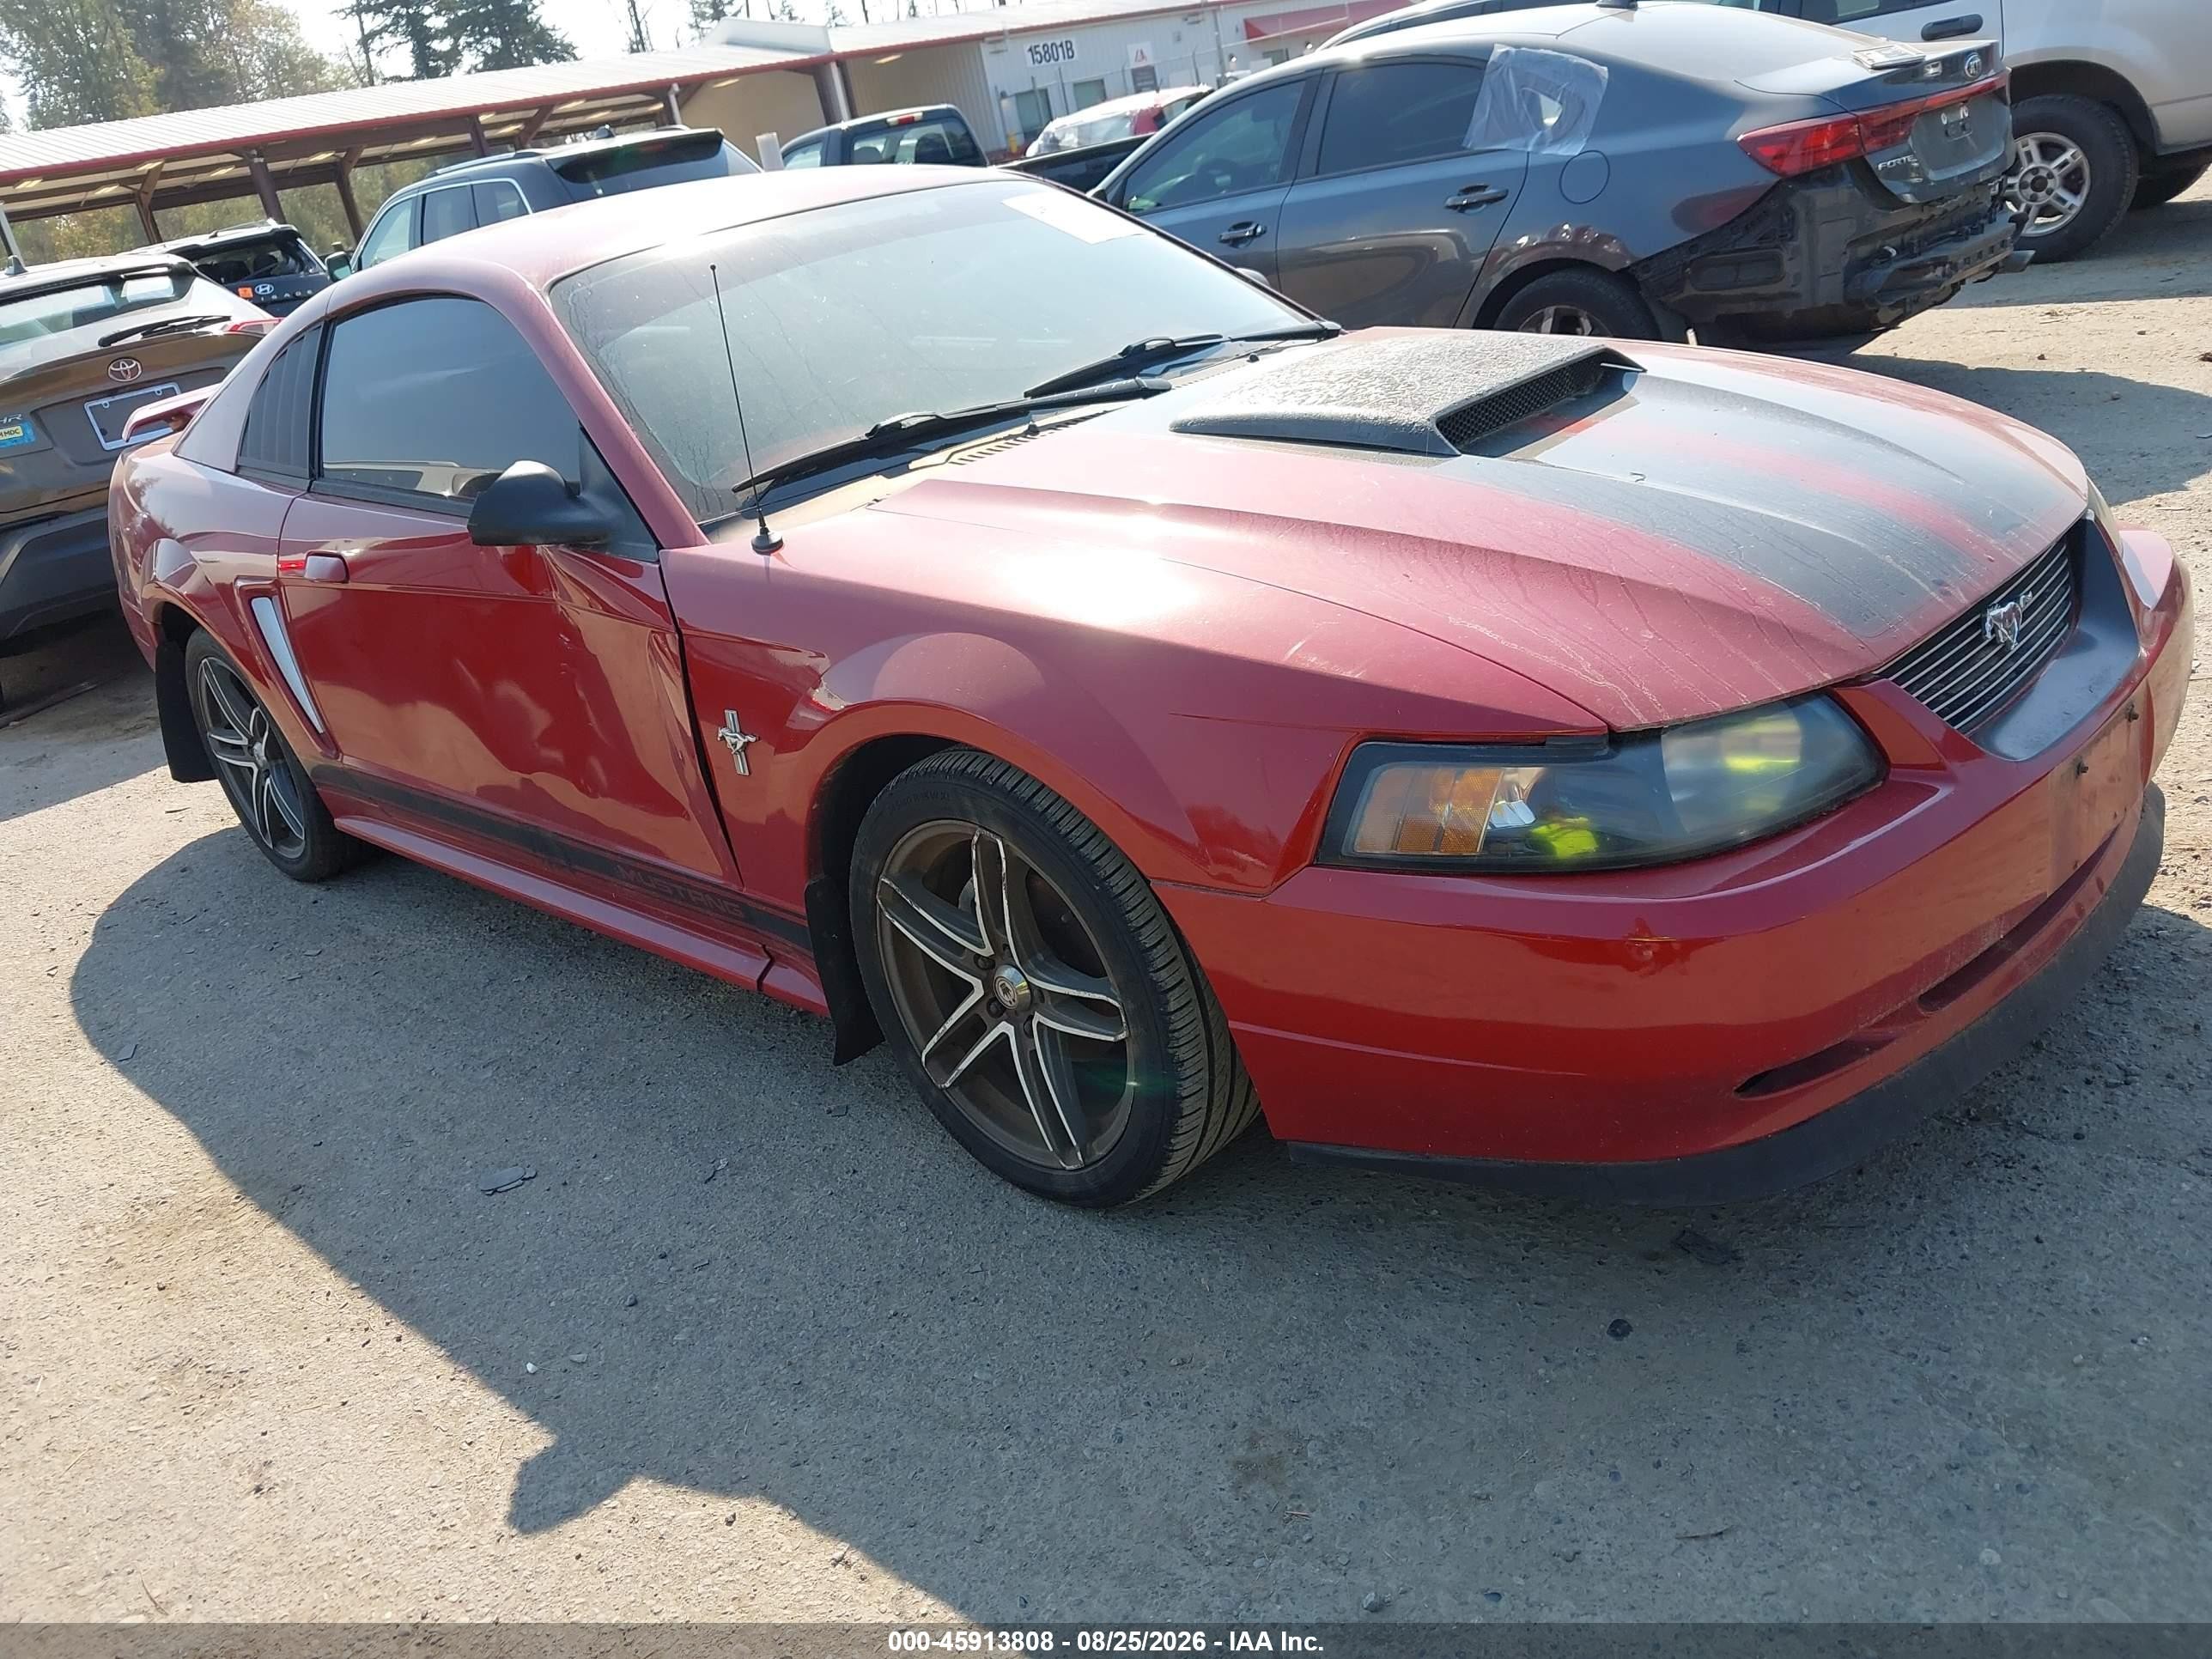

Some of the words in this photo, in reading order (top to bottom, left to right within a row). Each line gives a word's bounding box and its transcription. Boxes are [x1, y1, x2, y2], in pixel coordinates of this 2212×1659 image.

[1027, 40, 1074, 64] 15801B
[1878, 155, 1917, 171] FORTE
[617, 865, 743, 917] MUSTANG
